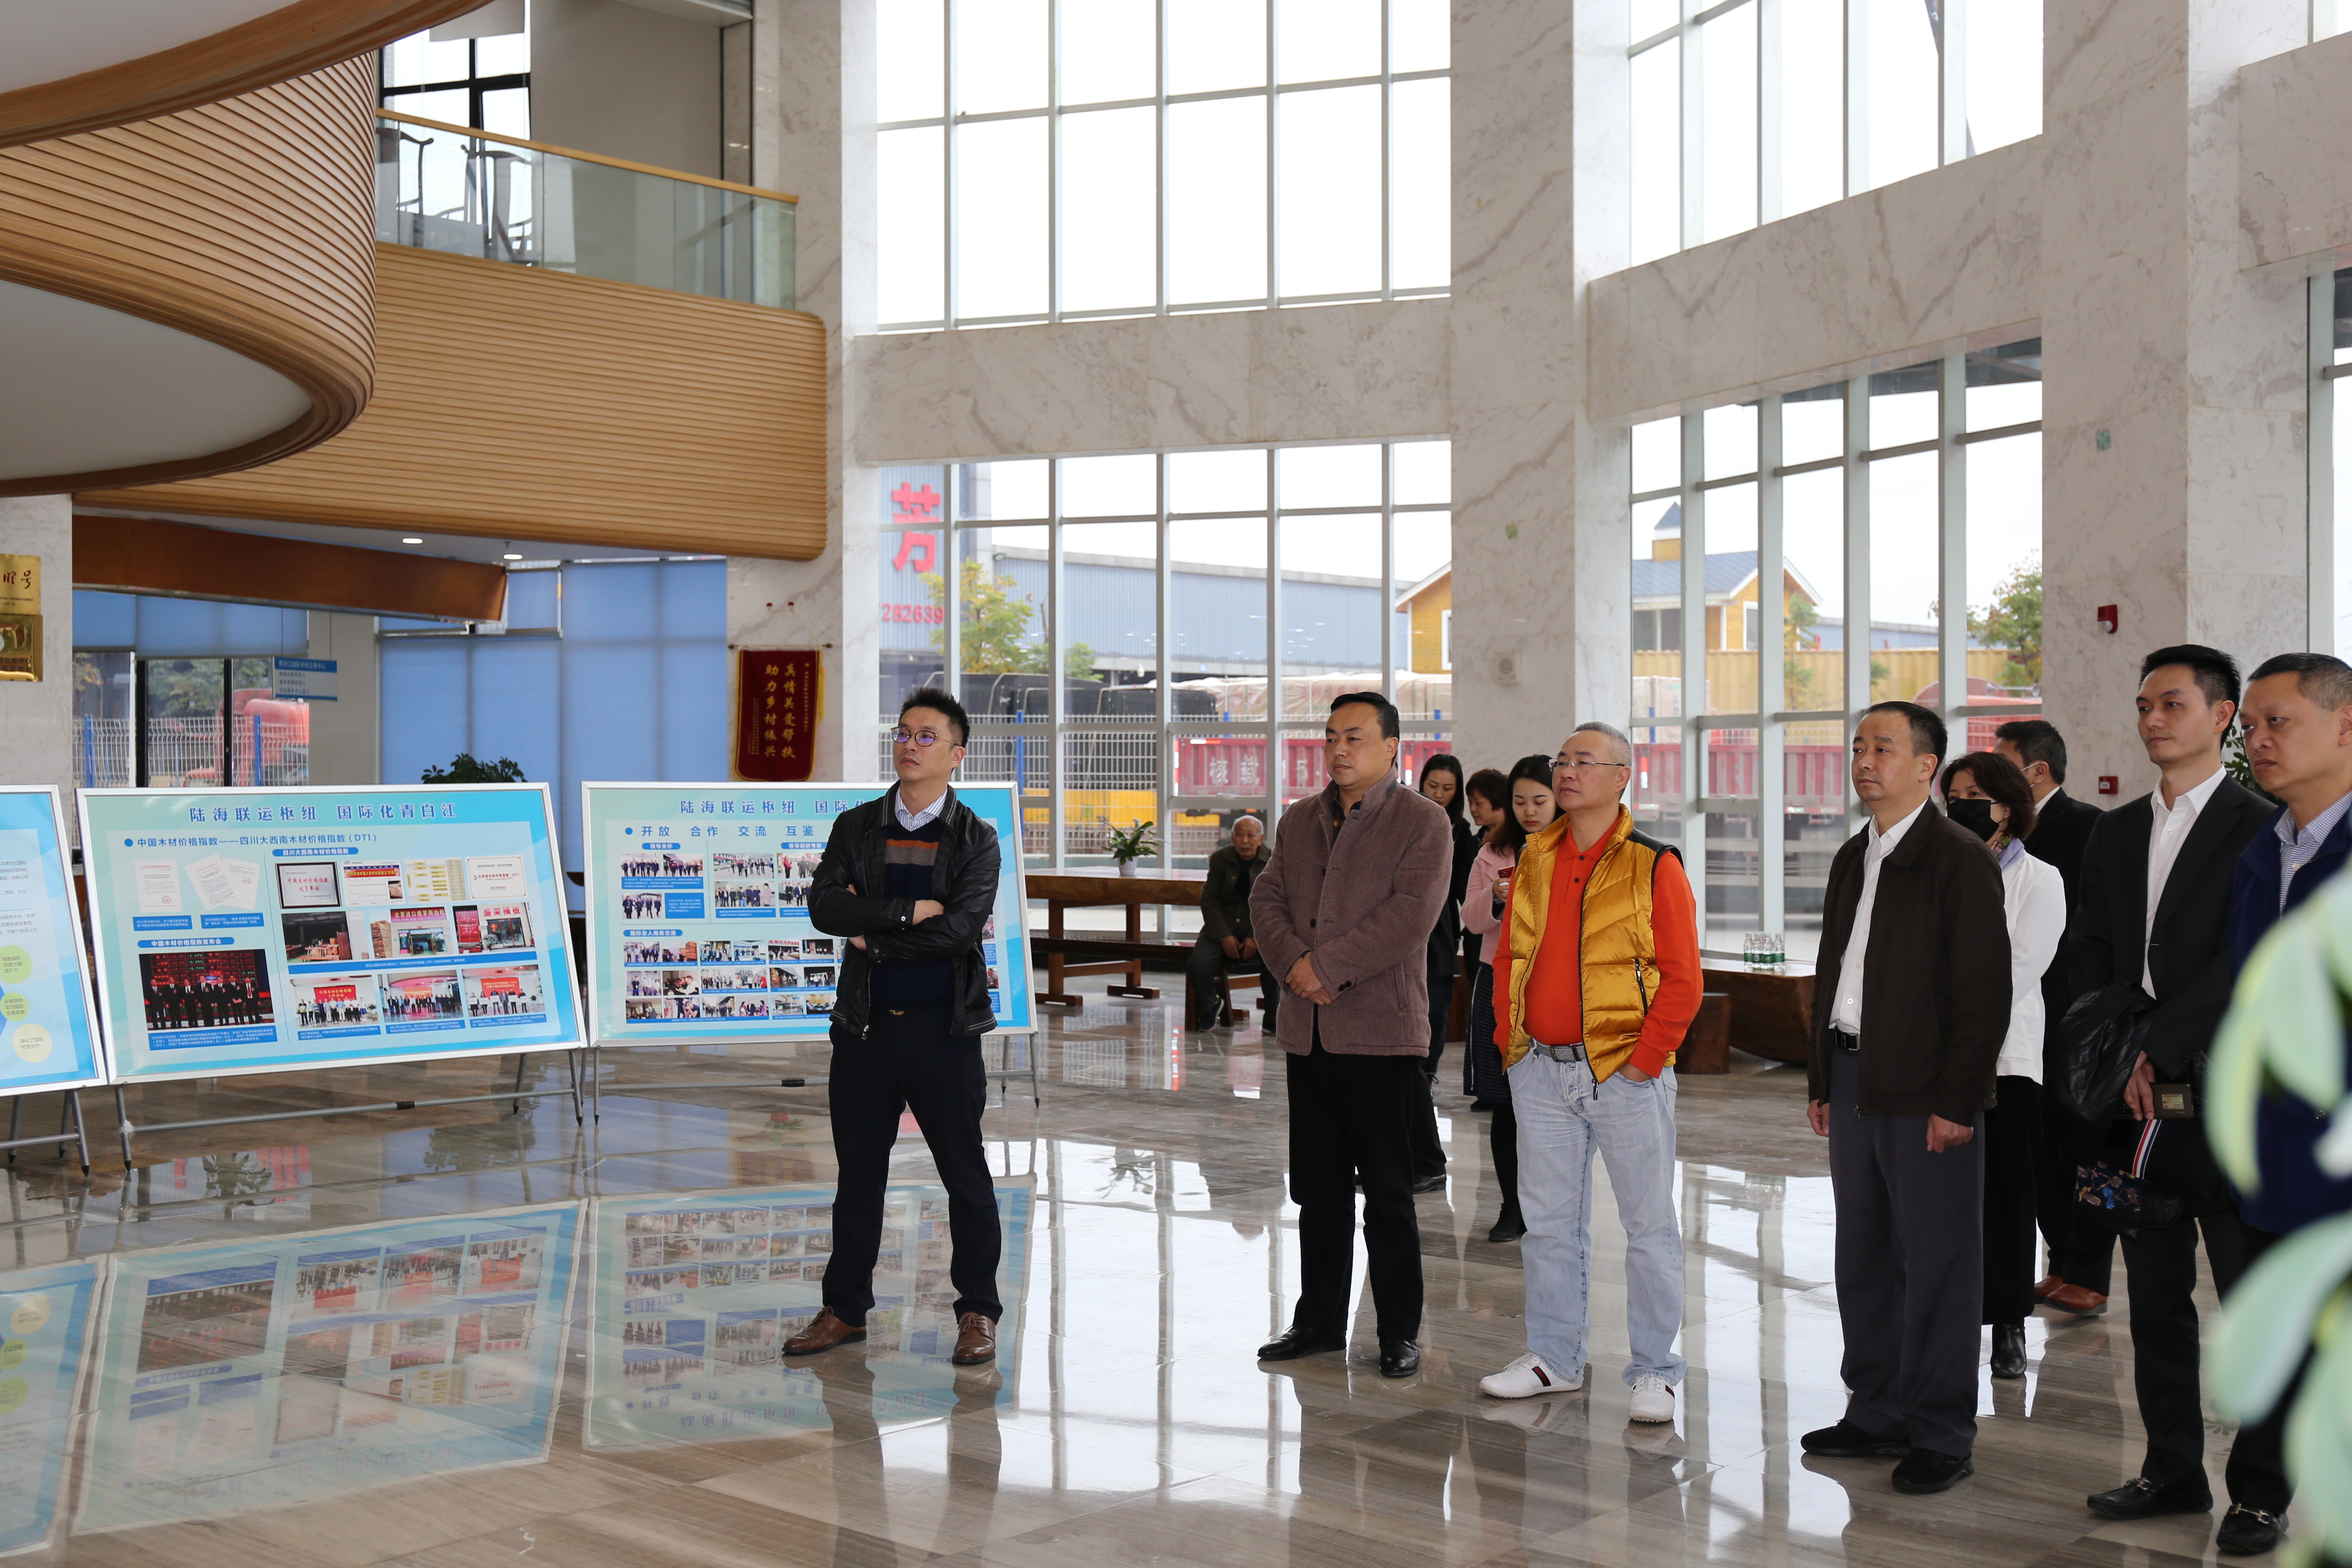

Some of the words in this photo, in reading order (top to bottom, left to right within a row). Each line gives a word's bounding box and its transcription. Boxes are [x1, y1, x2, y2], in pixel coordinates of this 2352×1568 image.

[892, 482, 941, 572] 芳
[879, 602, 944, 625] 282639
[189, 805, 317, 822] 陆海联运枢纽
[337, 803, 456, 820] 国际化青白江
[680, 800, 796, 814] 陆海联运枢纽
[641, 826, 670, 837] 开放
[690, 826, 718, 837] 合作
[738, 825, 766, 836] 交流
[786, 825, 814, 836] 互鉴
[282, 848, 349, 856] 四川大西南木材价格指数
[151, 938, 222, 947] 中国木材价格指数发布会
